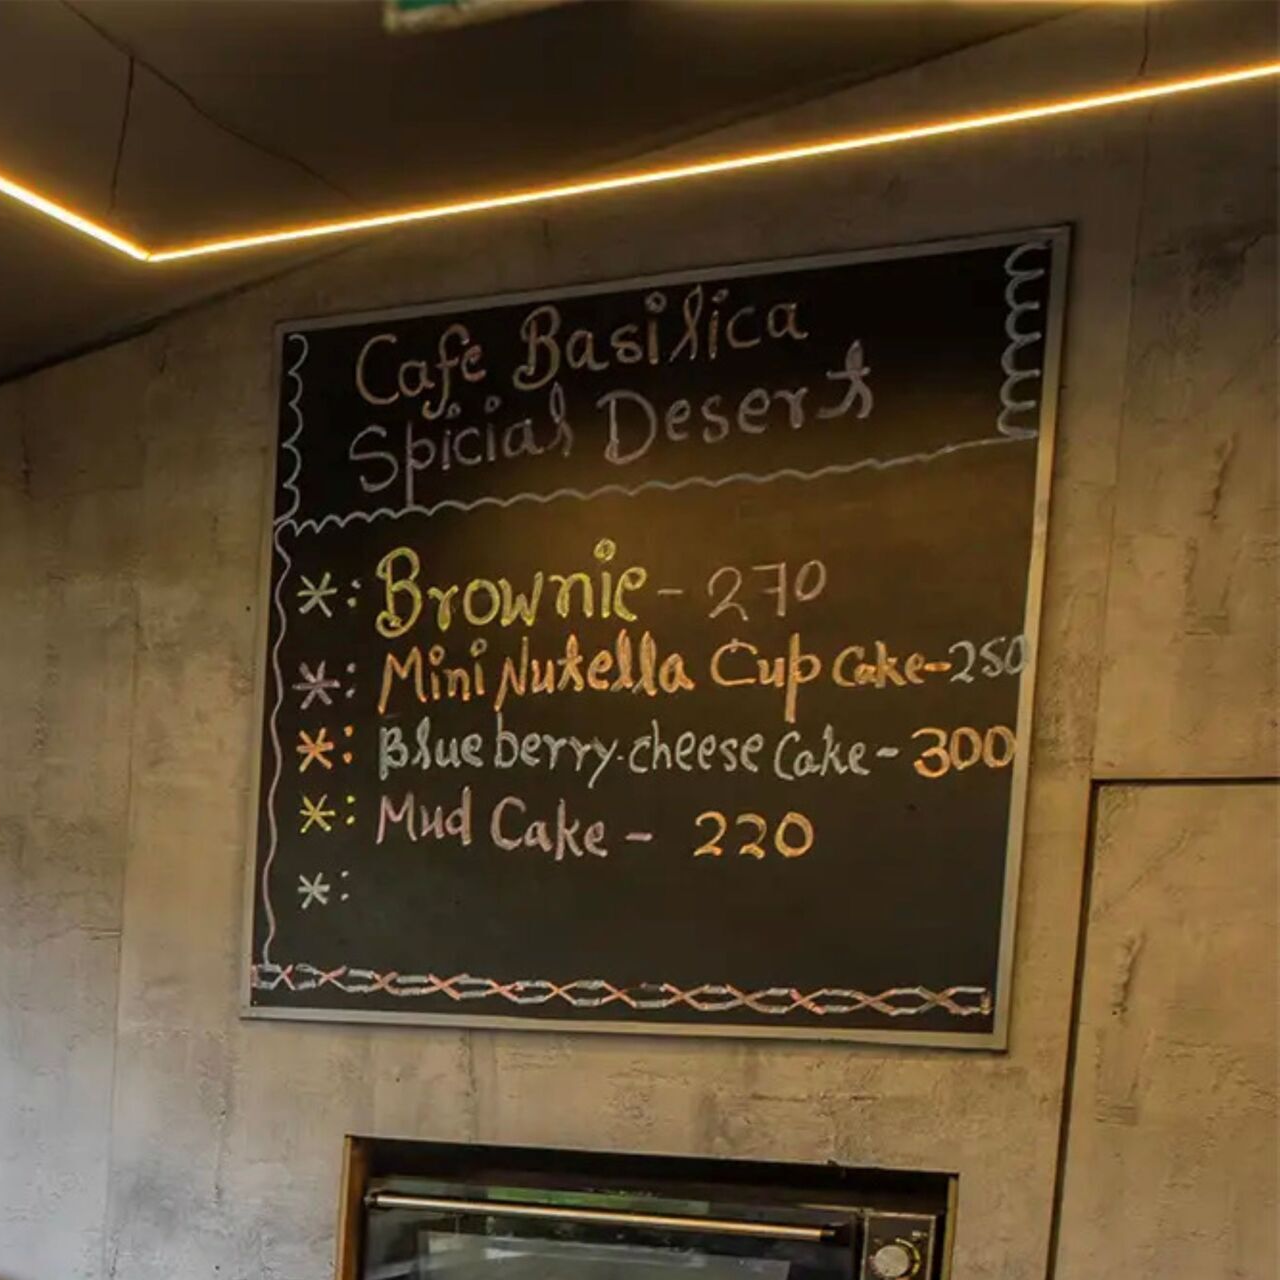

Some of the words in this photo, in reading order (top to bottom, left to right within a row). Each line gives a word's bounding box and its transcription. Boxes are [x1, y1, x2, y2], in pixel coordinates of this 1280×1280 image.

[355, 323, 487, 420] Cafe
[512, 284, 809, 391] Basilica
[349, 382, 573, 507] Spicial
[596, 339, 874, 465] Desert
[375, 538, 647, 638] Brownie
[707, 559, 827, 622] 270
[377, 638, 487, 715] Mini
[493, 629, 695, 712] Nutella
[709, 632, 822, 724] Cup
[773, 723, 871, 781] Cake
[910, 725, 1017, 778] 300
[376, 785, 472, 846] Mud
[490, 796, 608, 862] Cake
[693, 811, 814, 860] 220
